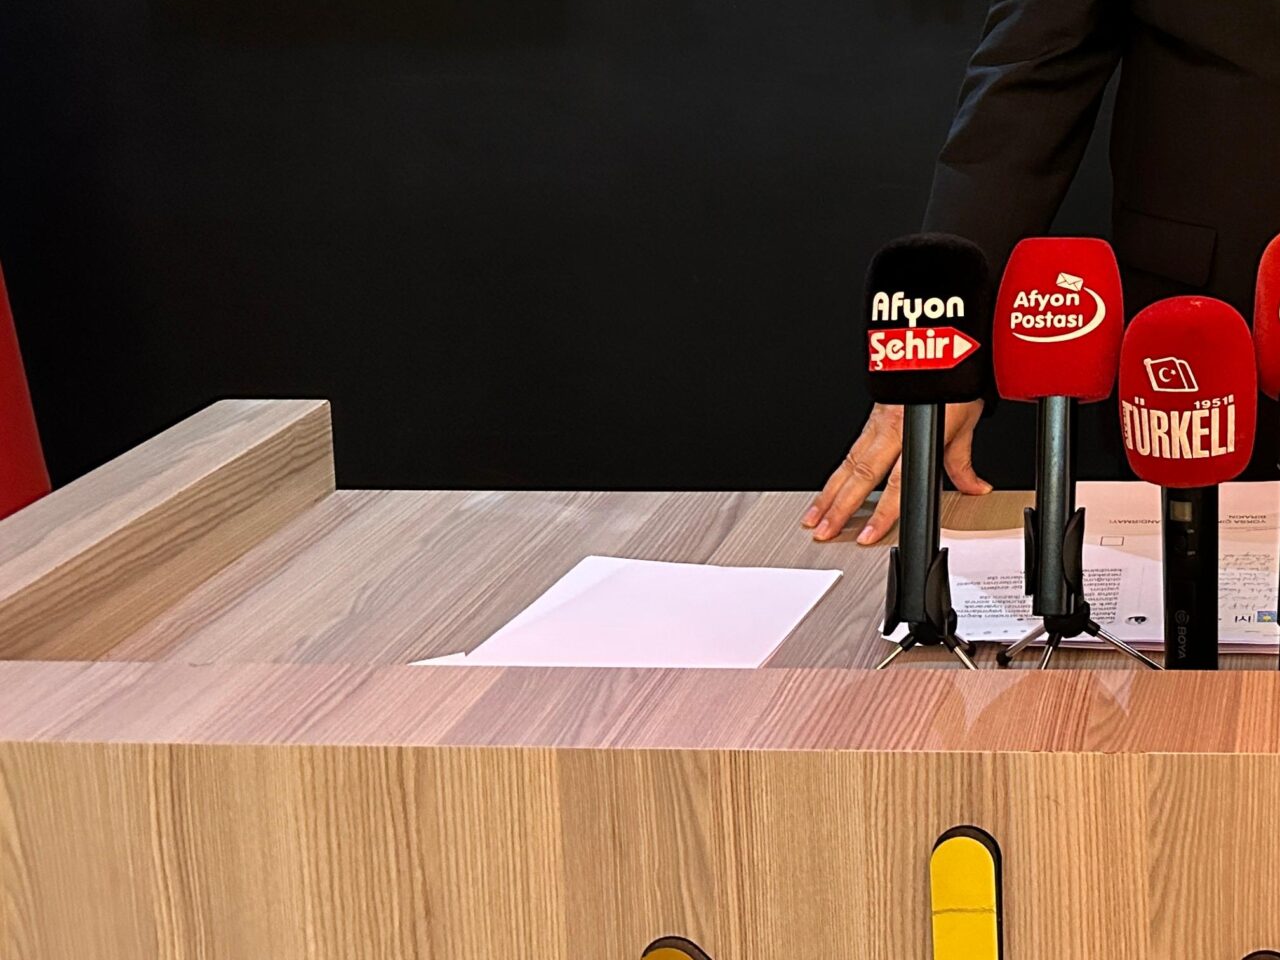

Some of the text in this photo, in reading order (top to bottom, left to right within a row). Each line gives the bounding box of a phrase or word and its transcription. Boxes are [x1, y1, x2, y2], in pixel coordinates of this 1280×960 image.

[871, 291, 965, 328] Afyon
[1013, 289, 1080, 312] Afyon
[1010, 311, 1084, 330] Postası
[869, 330, 950, 371] Şehir
[1193, 397, 1228, 410] 1951
[1121, 394, 1235, 460] TÜRKELİ
[1177, 626, 1188, 660] BOYA
